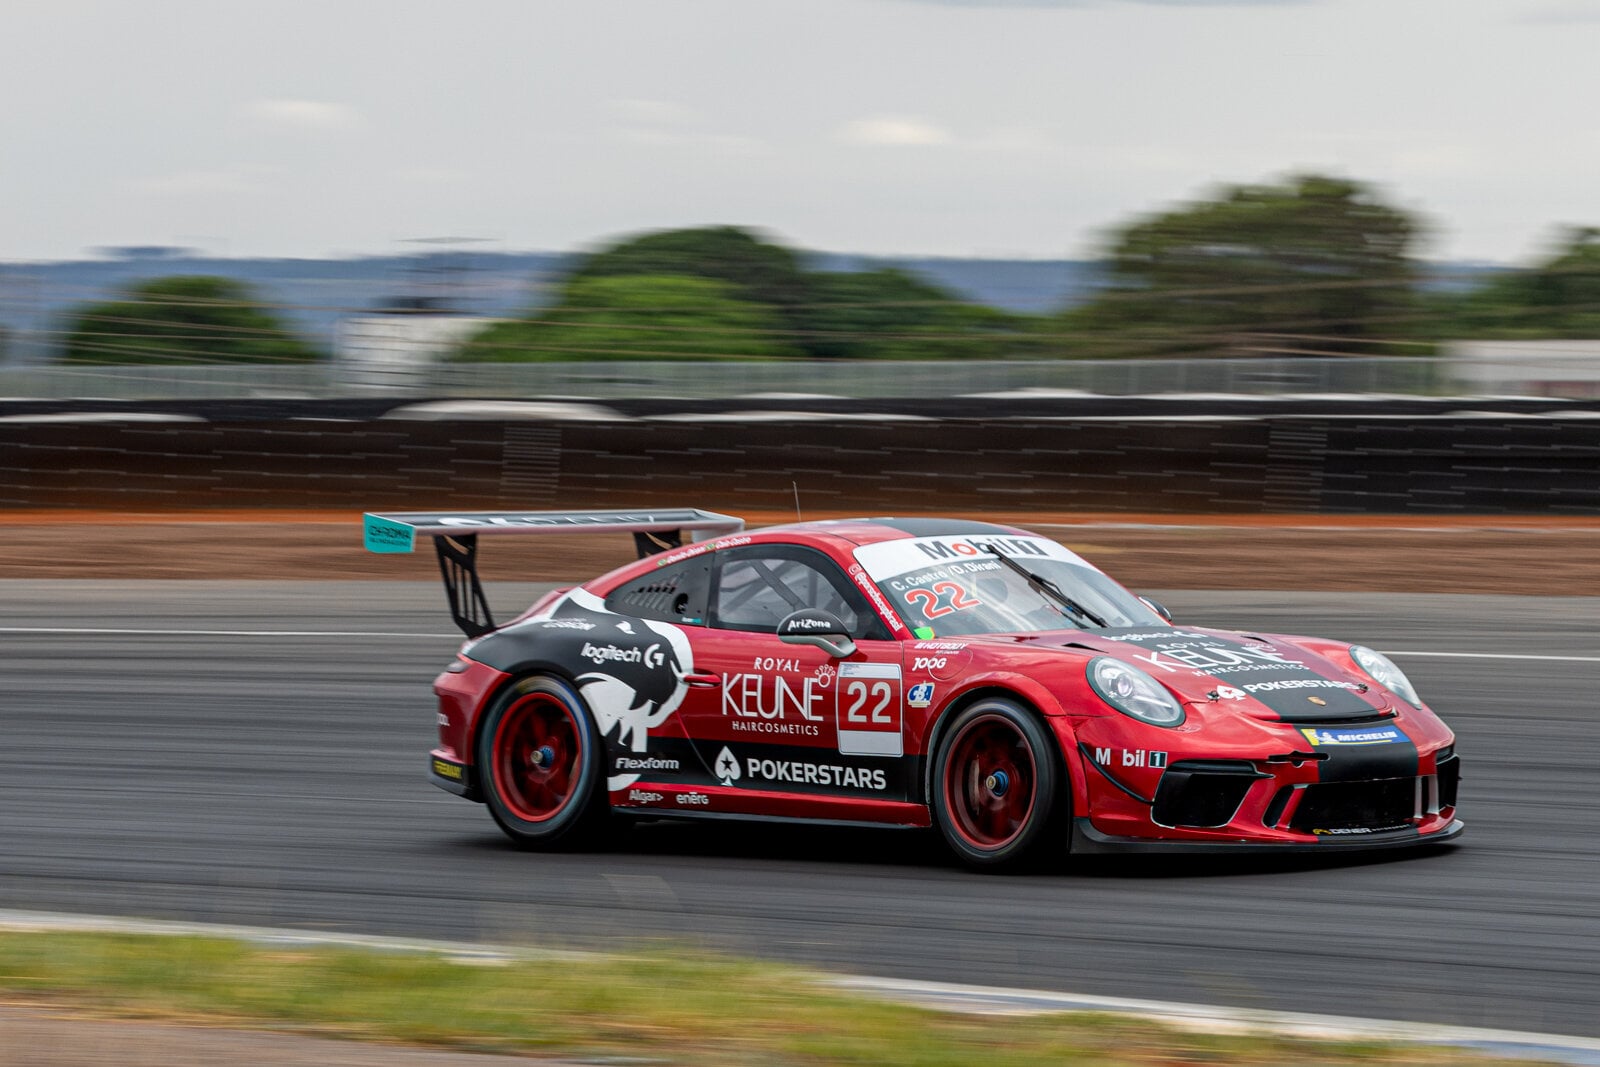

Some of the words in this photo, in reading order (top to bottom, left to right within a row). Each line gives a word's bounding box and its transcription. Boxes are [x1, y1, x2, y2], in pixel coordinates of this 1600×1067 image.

[914, 538, 1019, 560] Mobil
[905, 570, 948, 586] Castro
[904, 581, 983, 620] 22
[580, 642, 642, 664] logitech
[754, 657, 800, 672] ROYAL
[1243, 679, 1360, 693] POKERSTARS
[722, 672, 825, 721] KEUNE
[847, 681, 892, 723] 22
[732, 720, 819, 736] HAIRCOSMETICS
[1336, 731, 1398, 742] MICHELIN
[615, 757, 680, 769] Flexform
[1095, 747, 1146, 767] Mbil
[747, 758, 887, 790] POKERSTARS
